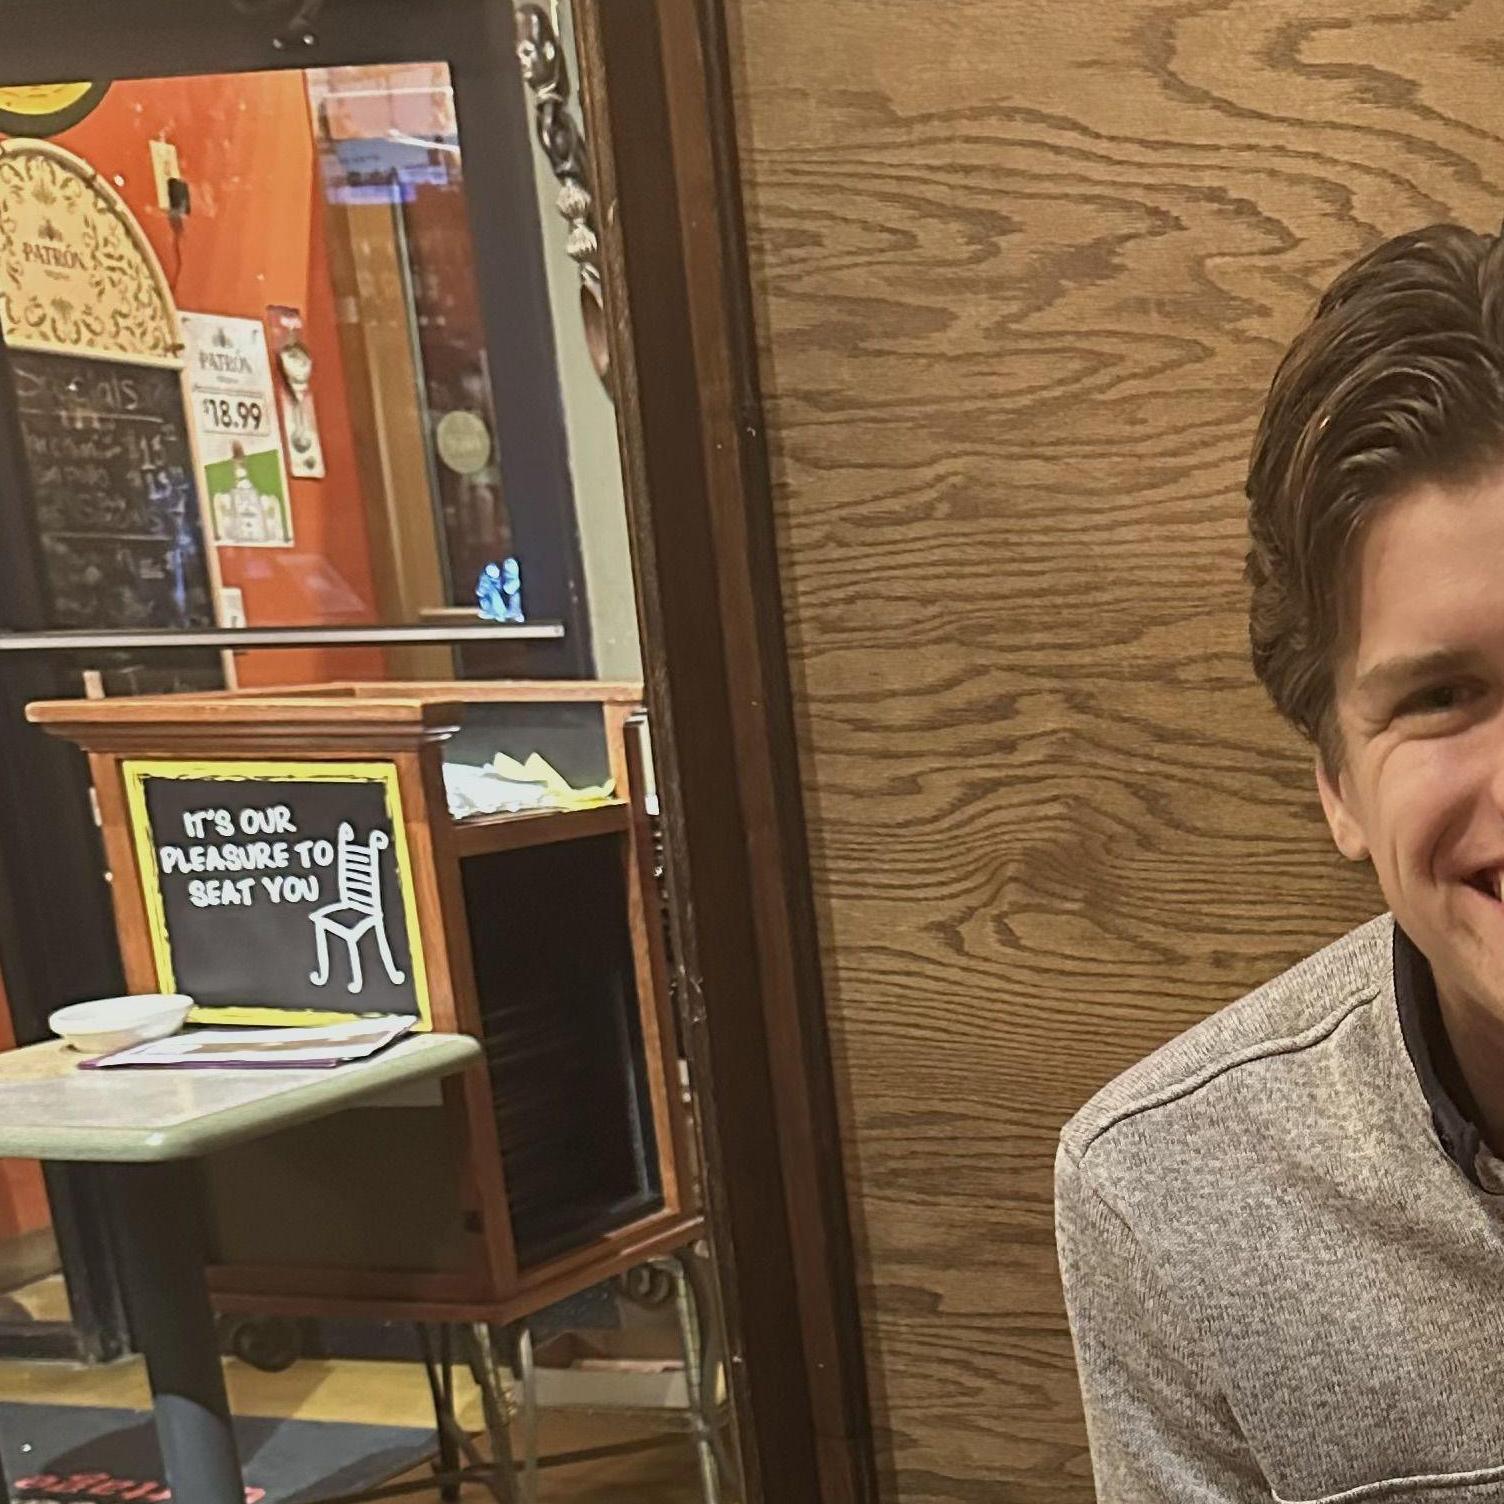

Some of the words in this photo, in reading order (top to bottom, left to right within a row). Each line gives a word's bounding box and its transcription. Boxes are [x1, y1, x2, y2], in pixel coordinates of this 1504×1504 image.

[183, 808, 235, 839] IT'S
[239, 805, 297, 835] OUR
[160, 841, 291, 874] PLEASURE
[293, 839, 335, 869] TO
[188, 877, 256, 908] SEAT
[260, 874, 320, 904] YOU
